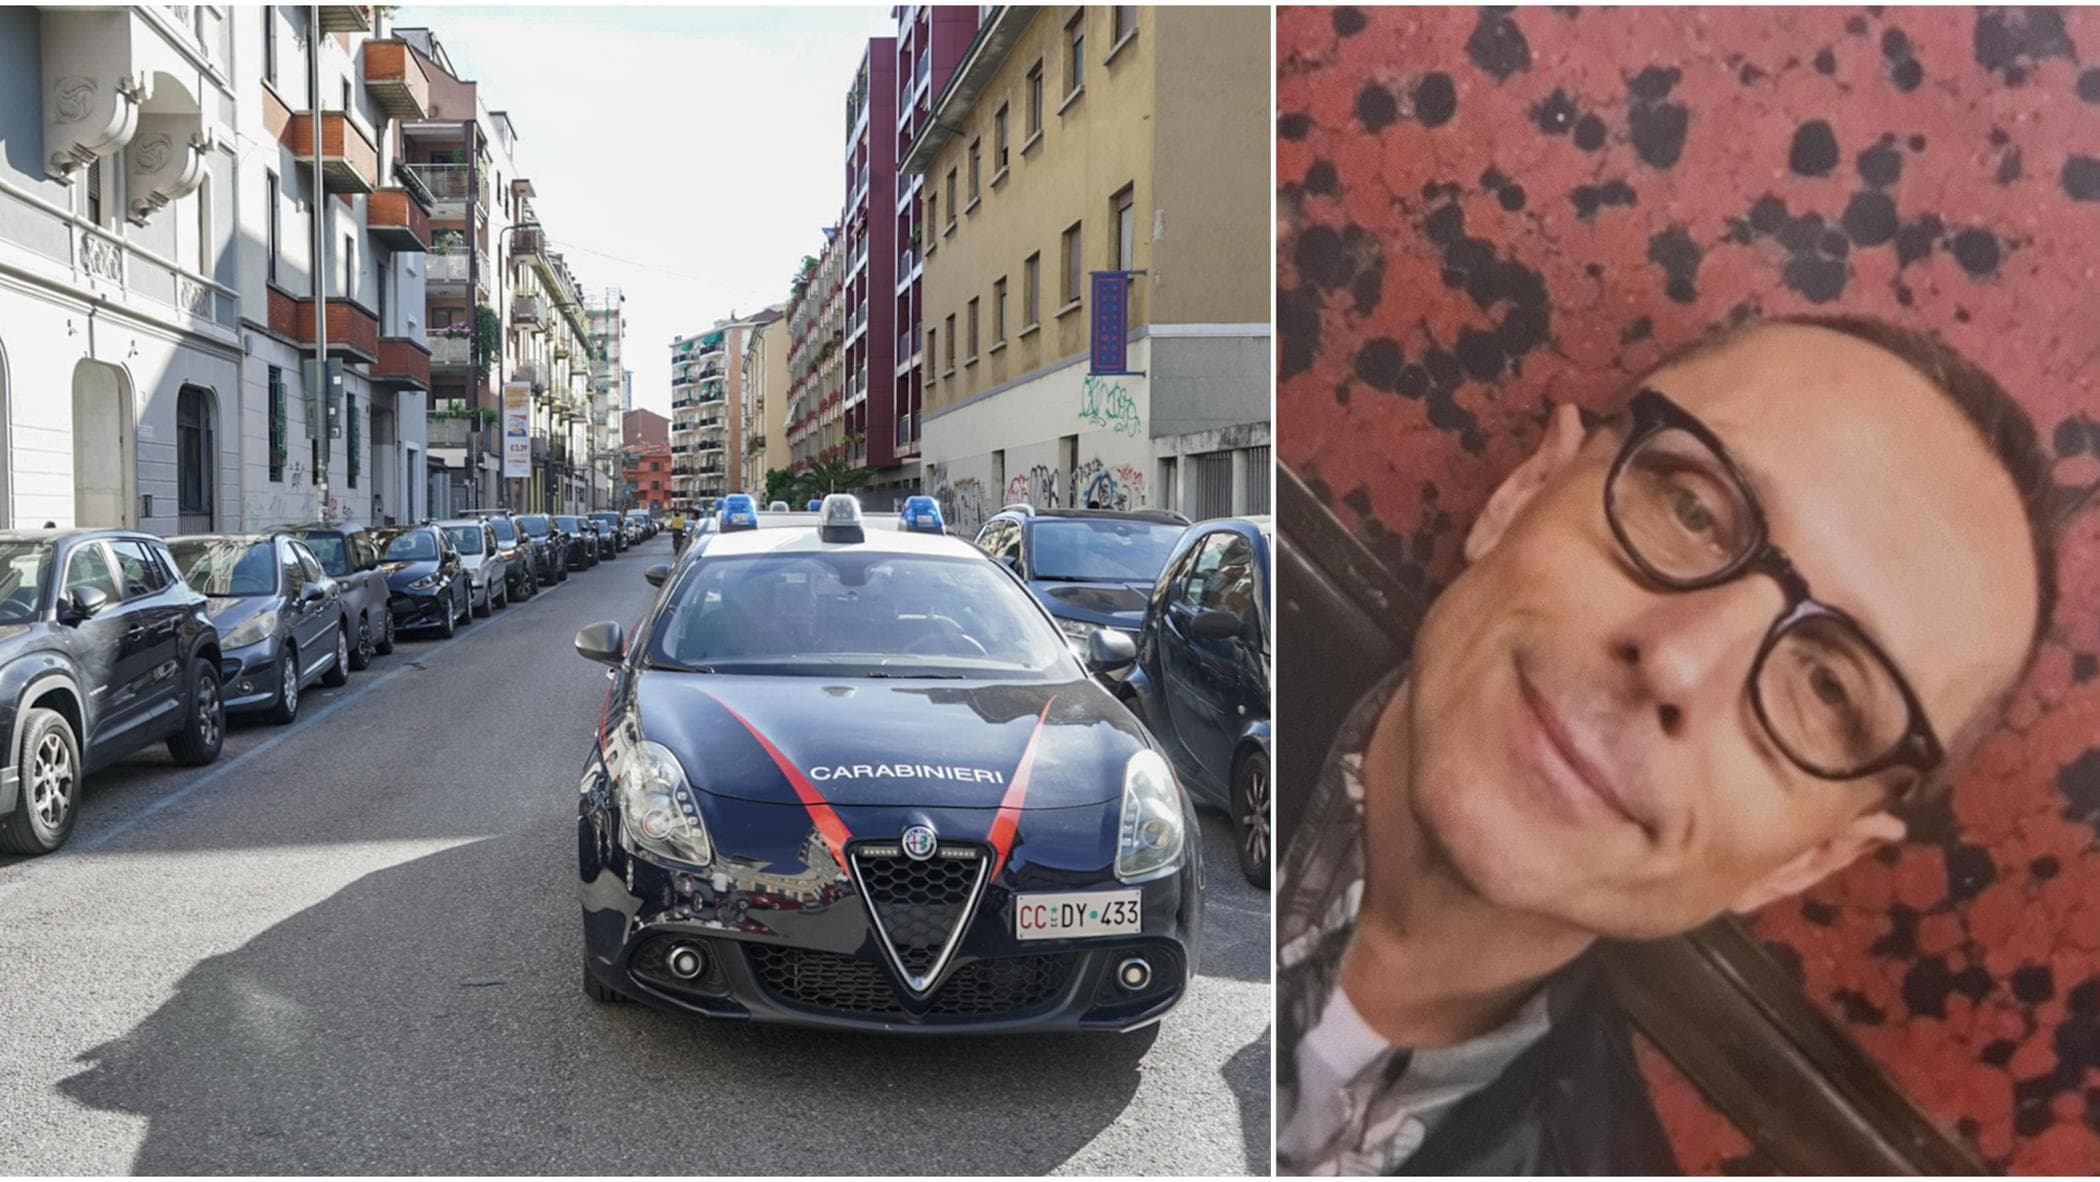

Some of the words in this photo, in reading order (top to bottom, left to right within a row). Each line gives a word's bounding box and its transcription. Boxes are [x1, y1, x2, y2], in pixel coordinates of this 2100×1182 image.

[810, 764, 1004, 784] CARABINIERI
[1020, 905, 1047, 929] CC
[1061, 903, 1087, 928] DY
[1100, 901, 1139, 926] 433
